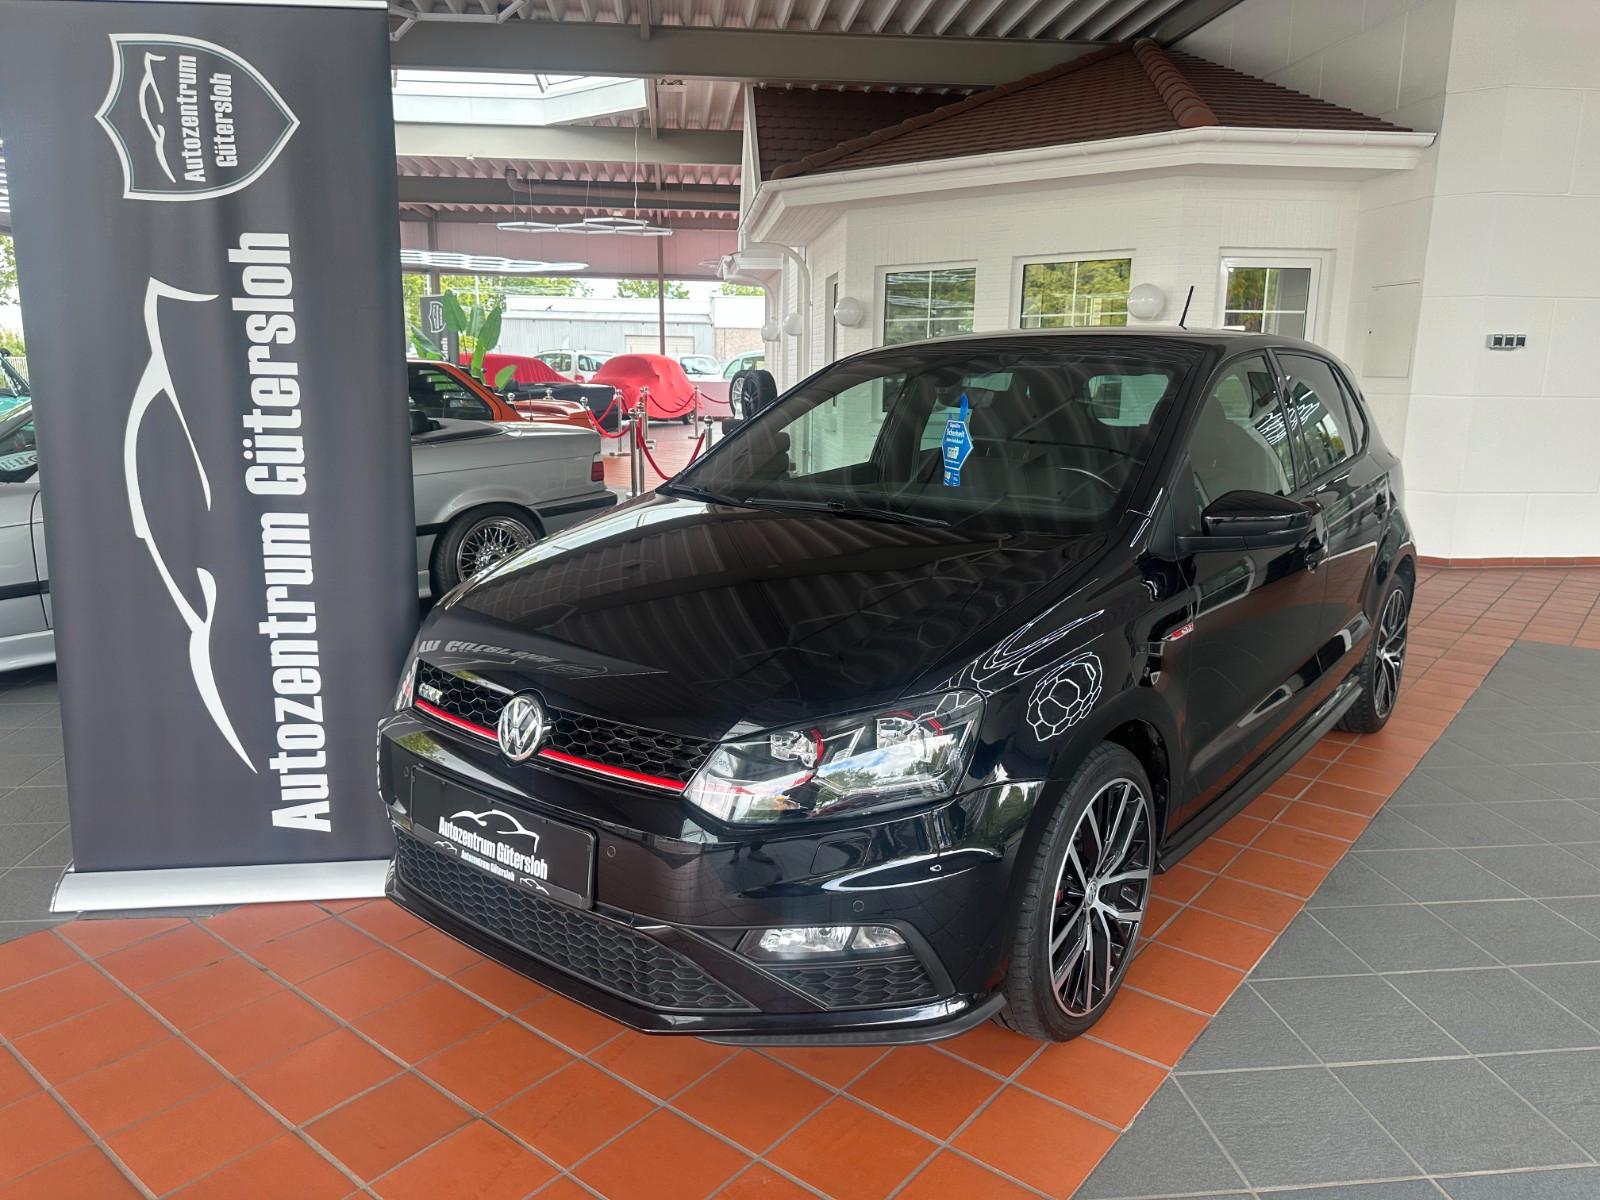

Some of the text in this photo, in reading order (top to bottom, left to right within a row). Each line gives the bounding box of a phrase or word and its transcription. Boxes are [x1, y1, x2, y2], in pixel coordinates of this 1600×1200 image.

[178, 55, 206, 183] Autozentrum
[209, 73, 238, 167] Gütersloh
[228, 233, 331, 832] Autozentrum Gütersloh
[438, 816, 549, 880] Autozentrum Gütersloh
